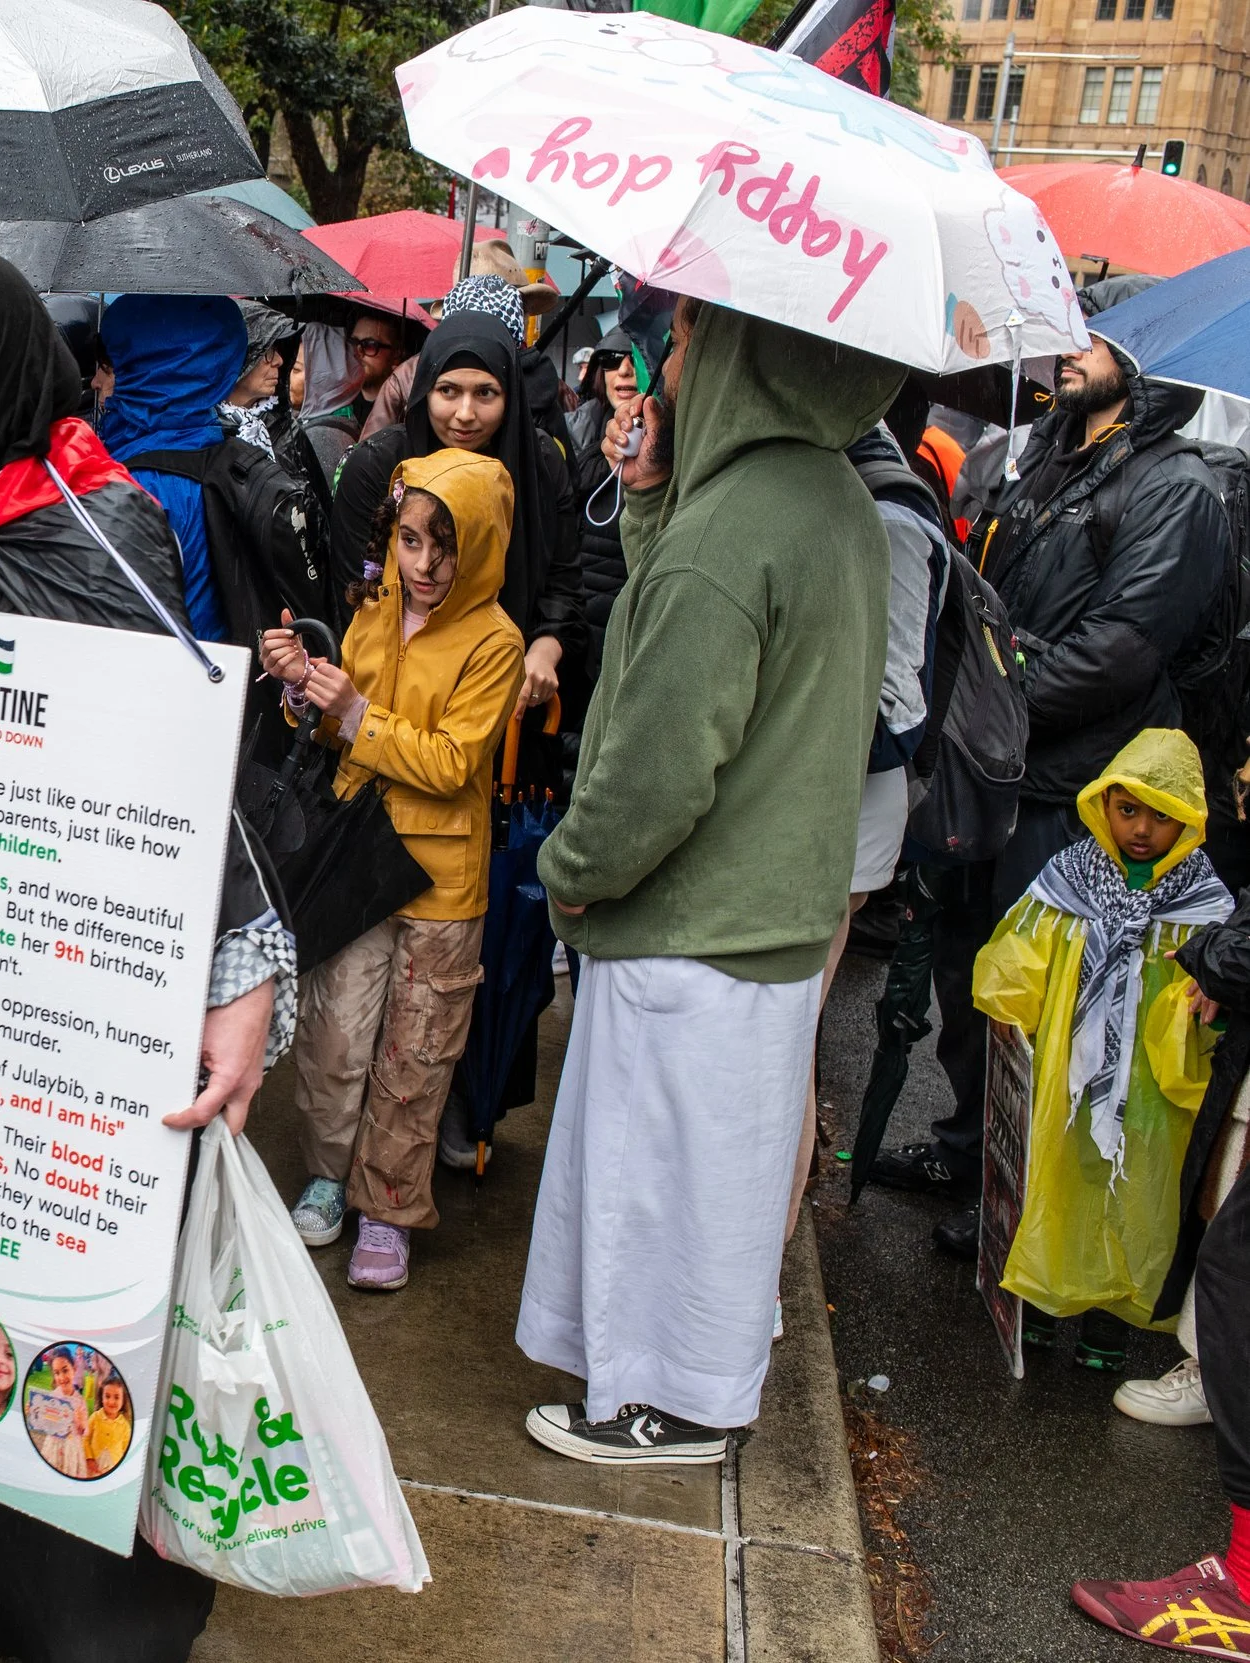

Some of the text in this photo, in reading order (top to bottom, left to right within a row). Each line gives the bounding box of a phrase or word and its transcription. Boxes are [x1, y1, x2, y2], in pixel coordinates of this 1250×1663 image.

[119, 147, 213, 177] LEXUS SUTHERLAND
[5, 730, 43, 749] DOWN
[9, 779, 42, 804] just
[47, 787, 76, 810] like
[81, 799, 112, 817] our
[116, 803, 196, 834] children.
[66, 819, 100, 844] just
[105, 827, 136, 851] like
[141, 834, 181, 860] how
[6, 900, 35, 925] But
[40, 910, 69, 932] the
[73, 918, 165, 955] difference
[170, 939, 185, 960] is
[18, 880, 51, 900] and
[55, 889, 98, 911] wore
[103, 895, 184, 931] beautiful
[21, 931, 50, 955] her
[54, 940, 85, 964] 9th
[90, 948, 167, 988] birthday,
[1, 998, 99, 1039] oppression,
[105, 1020, 174, 1060] hunger,
[9, 1094, 43, 1115] and
[57, 1108, 85, 1128] am
[12, 1063, 89, 1104] Julaybib,
[94, 1090, 105, 1105] a
[110, 1095, 149, 1118] man
[3, 1125, 47, 1155] Their
[51, 1140, 104, 1173] blood
[109, 1157, 123, 1179] is
[128, 1169, 159, 1190] our
[14, 1157, 40, 1181] No
[45, 1169, 100, 1201] doubt
[105, 1188, 148, 1215] their
[0, 1211, 17, 1230] to
[22, 1219, 51, 1242] the
[56, 1232, 87, 1254] sea
[38, 1198, 91, 1227] would
[96, 1212, 119, 1236] be
[182, 1519, 195, 1530] or
[245, 1525, 288, 1545] elivery
[291, 1518, 327, 1534] drive
